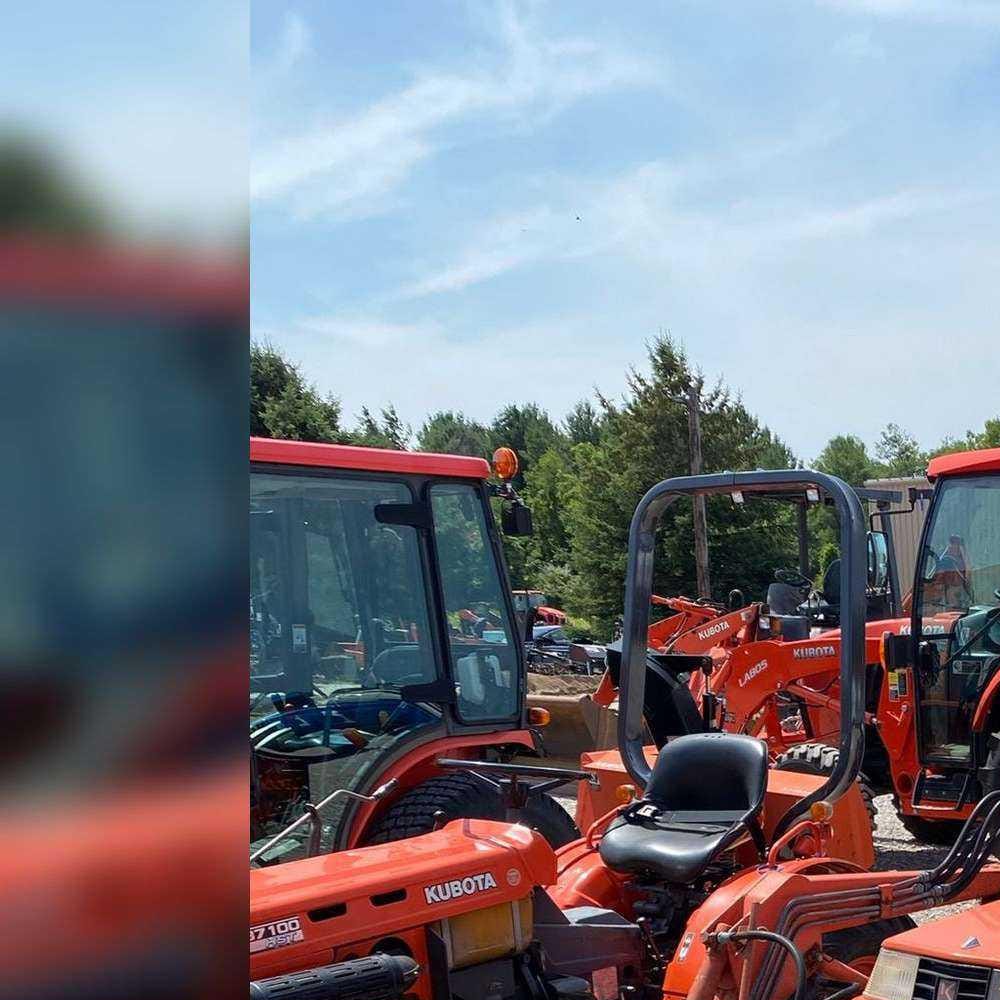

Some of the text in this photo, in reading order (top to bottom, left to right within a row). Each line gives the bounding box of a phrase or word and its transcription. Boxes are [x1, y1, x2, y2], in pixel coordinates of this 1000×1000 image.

[698, 621, 730, 640] KUBOTA
[899, 623, 945, 636] KOTA
[793, 646, 835, 658] KUBOTA
[424, 872, 497, 904] KUBOTA
